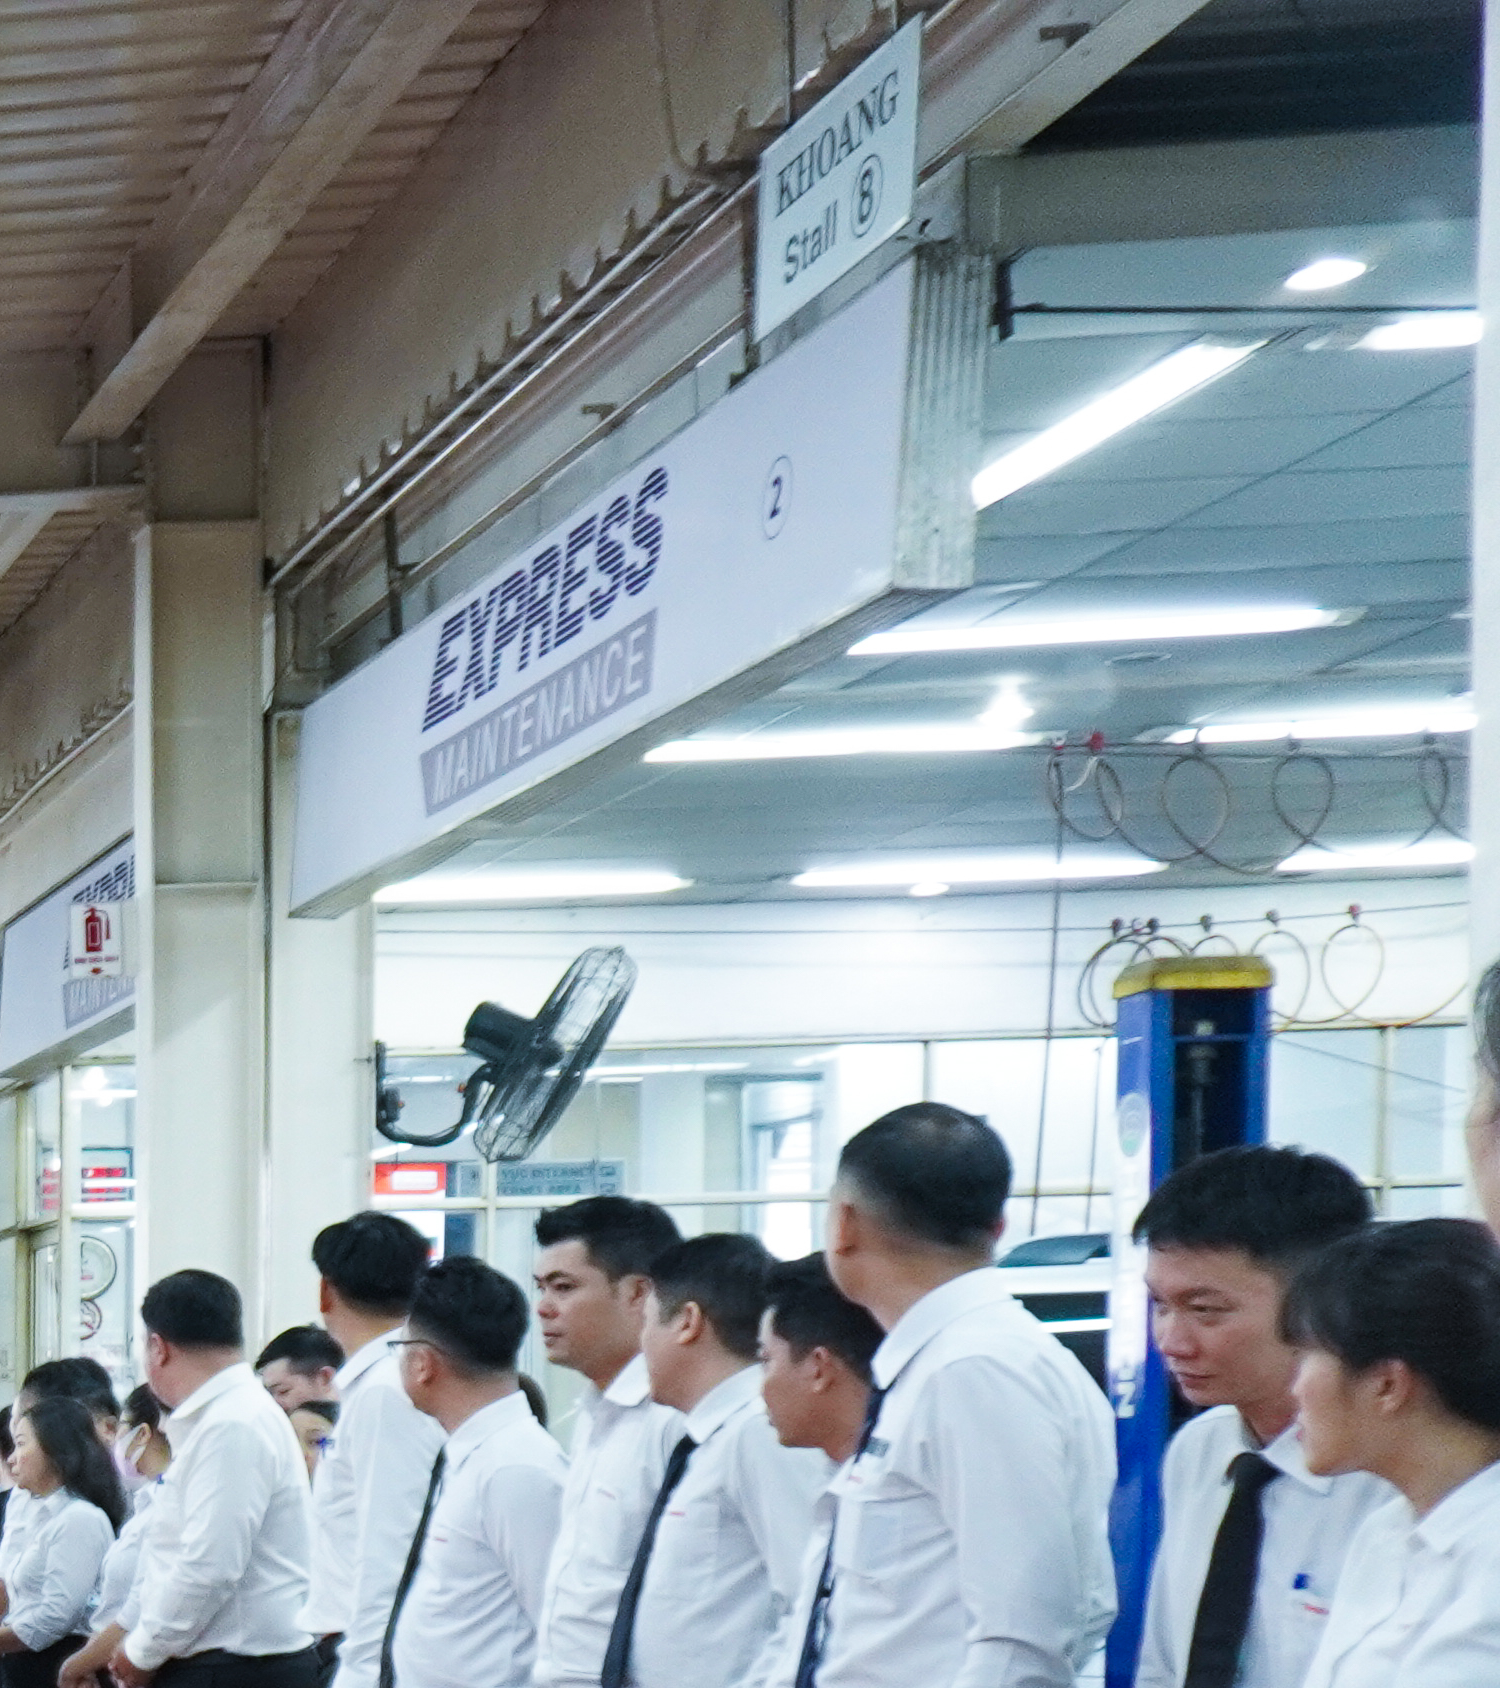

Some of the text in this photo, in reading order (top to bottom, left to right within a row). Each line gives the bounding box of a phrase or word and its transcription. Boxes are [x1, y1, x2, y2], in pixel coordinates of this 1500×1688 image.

[775, 70, 900, 218] KHOANG
[784, 199, 838, 284] Stall
[422, 466, 669, 733] EXPRESS
[432, 623, 649, 806] MAINTENANCE
